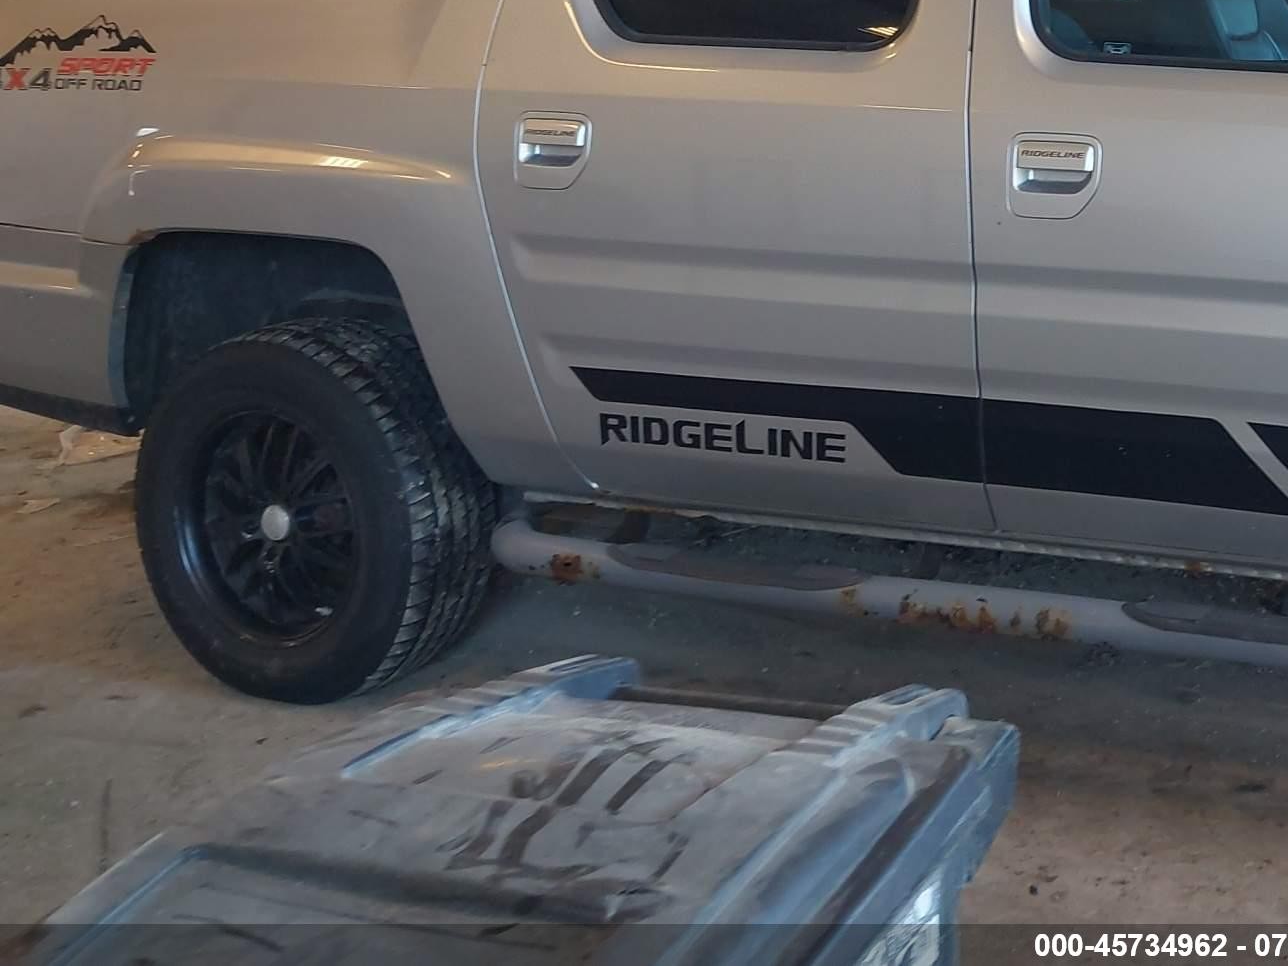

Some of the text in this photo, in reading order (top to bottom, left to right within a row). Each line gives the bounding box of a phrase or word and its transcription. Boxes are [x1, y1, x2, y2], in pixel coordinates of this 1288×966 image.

[58, 57, 156, 75] SPORT
[0, 68, 52, 91] X4
[55, 78, 142, 91] OFF ROAD
[1021, 149, 1085, 158] RIDGELINE
[599, 412, 846, 463] RIDGELINE
